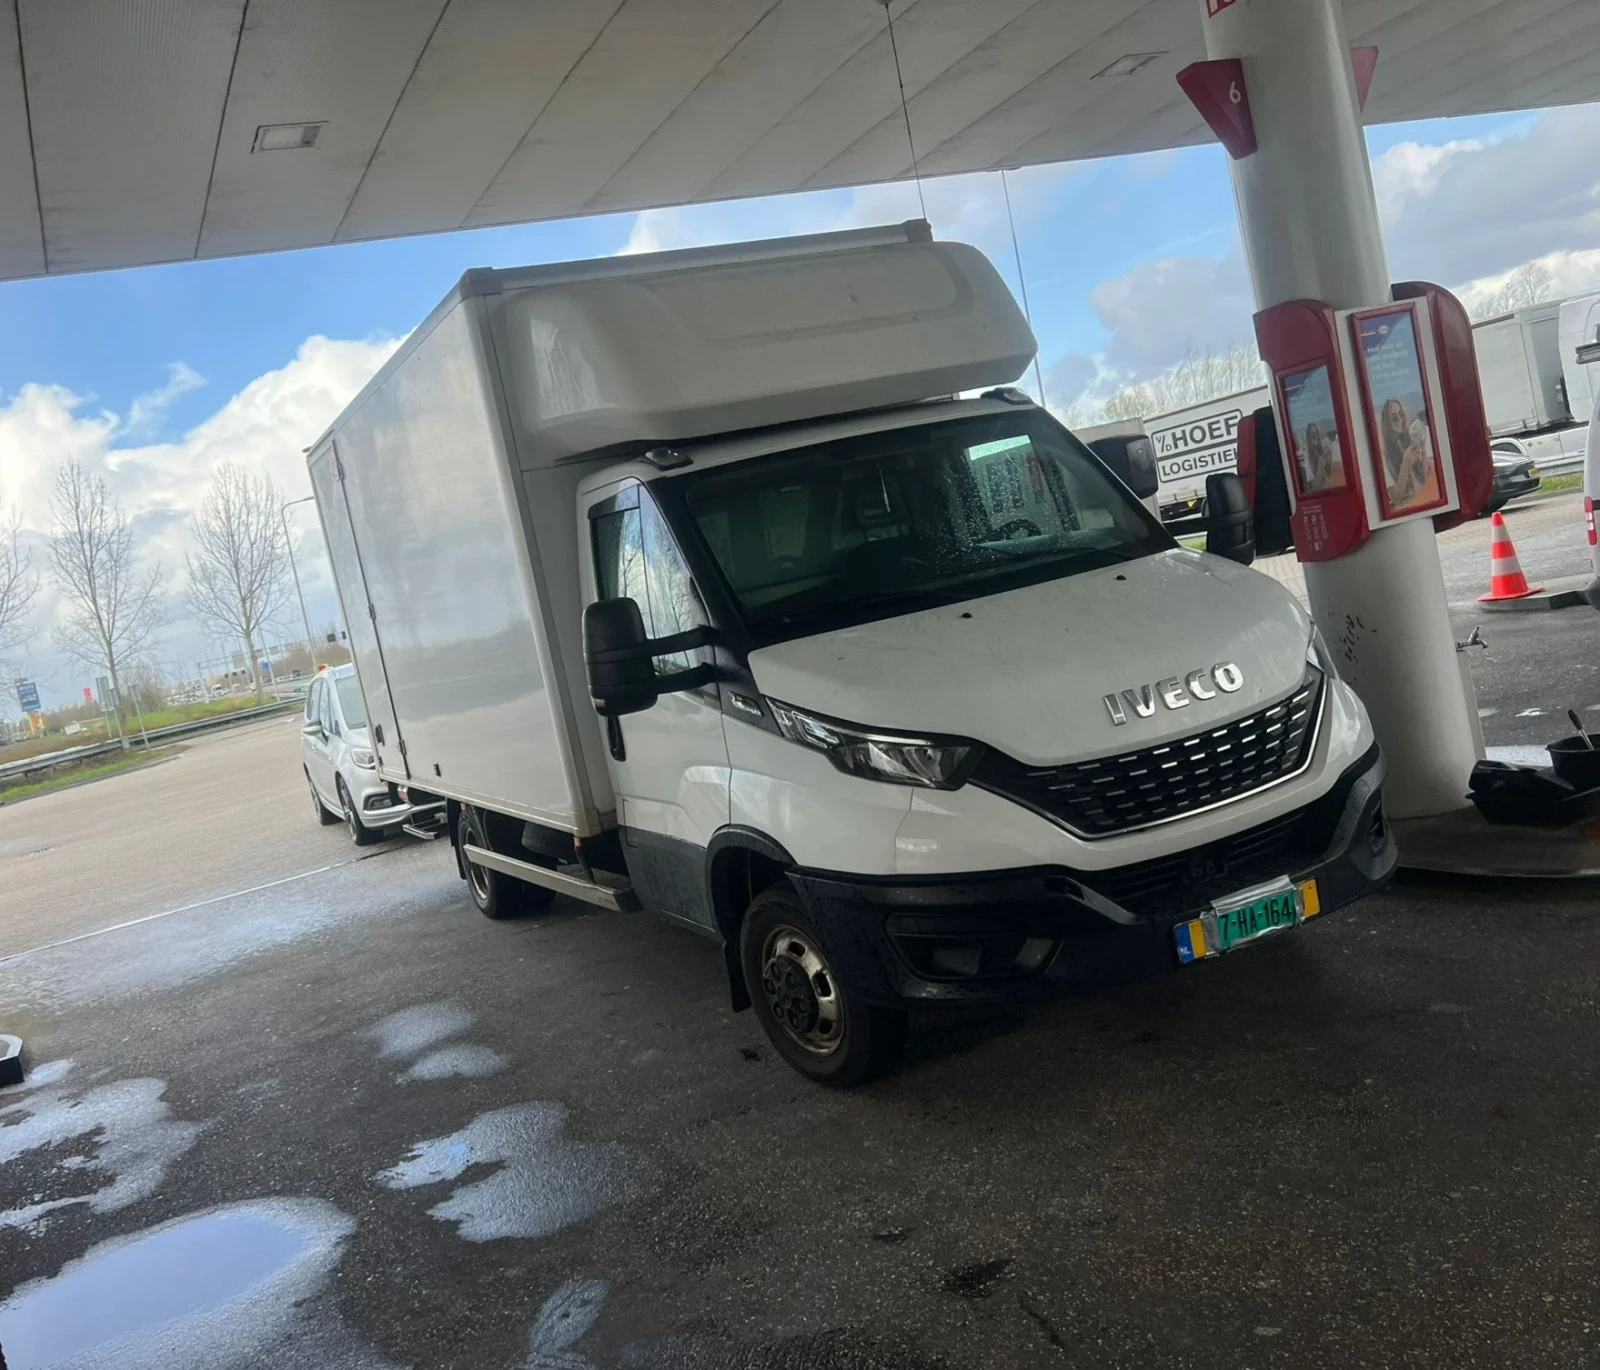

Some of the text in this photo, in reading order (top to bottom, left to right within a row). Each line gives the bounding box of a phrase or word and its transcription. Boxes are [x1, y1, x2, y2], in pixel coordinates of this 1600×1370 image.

[1229, 81, 1241, 104] 6
[1161, 448, 1238, 477] LOGISTIE
[1103, 661, 1244, 726] IVECO
[1219, 895, 1293, 942] 7-HA-164
[1180, 946, 1191, 956] NL
